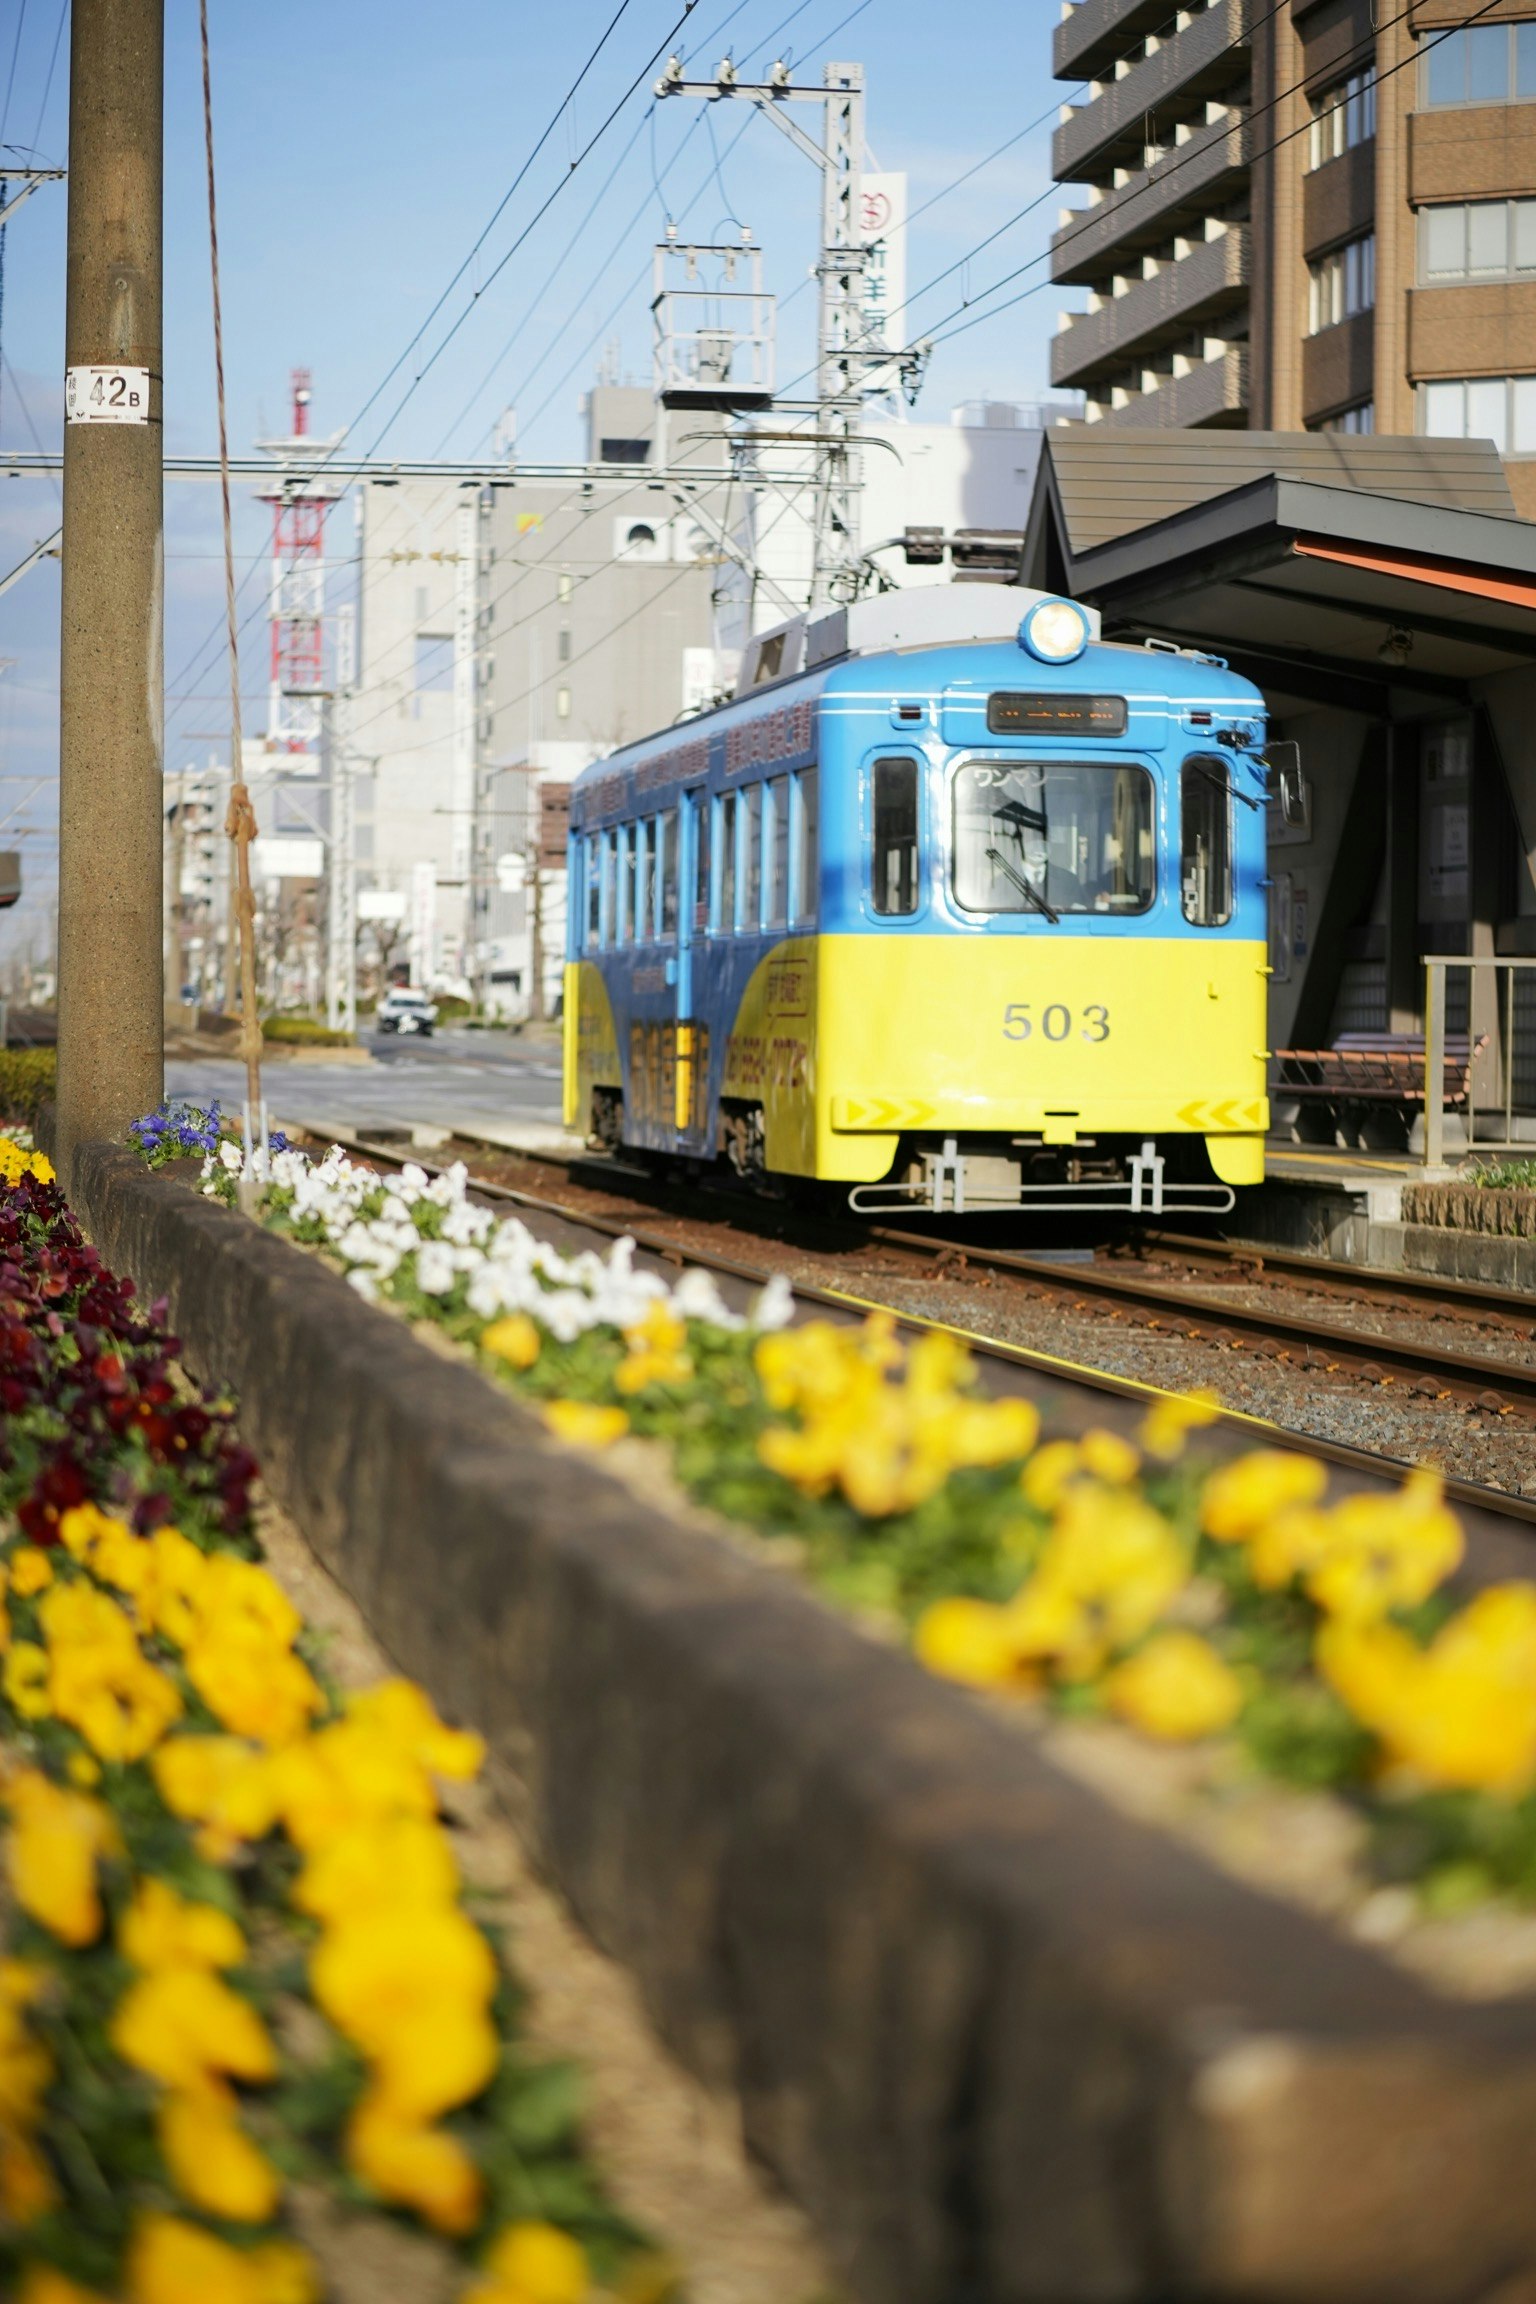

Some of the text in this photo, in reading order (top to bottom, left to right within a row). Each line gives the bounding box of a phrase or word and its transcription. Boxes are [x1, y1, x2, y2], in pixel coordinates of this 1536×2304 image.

[974, 768, 1049, 788] ワンマン
[1002, 1003, 1110, 1042] 503
